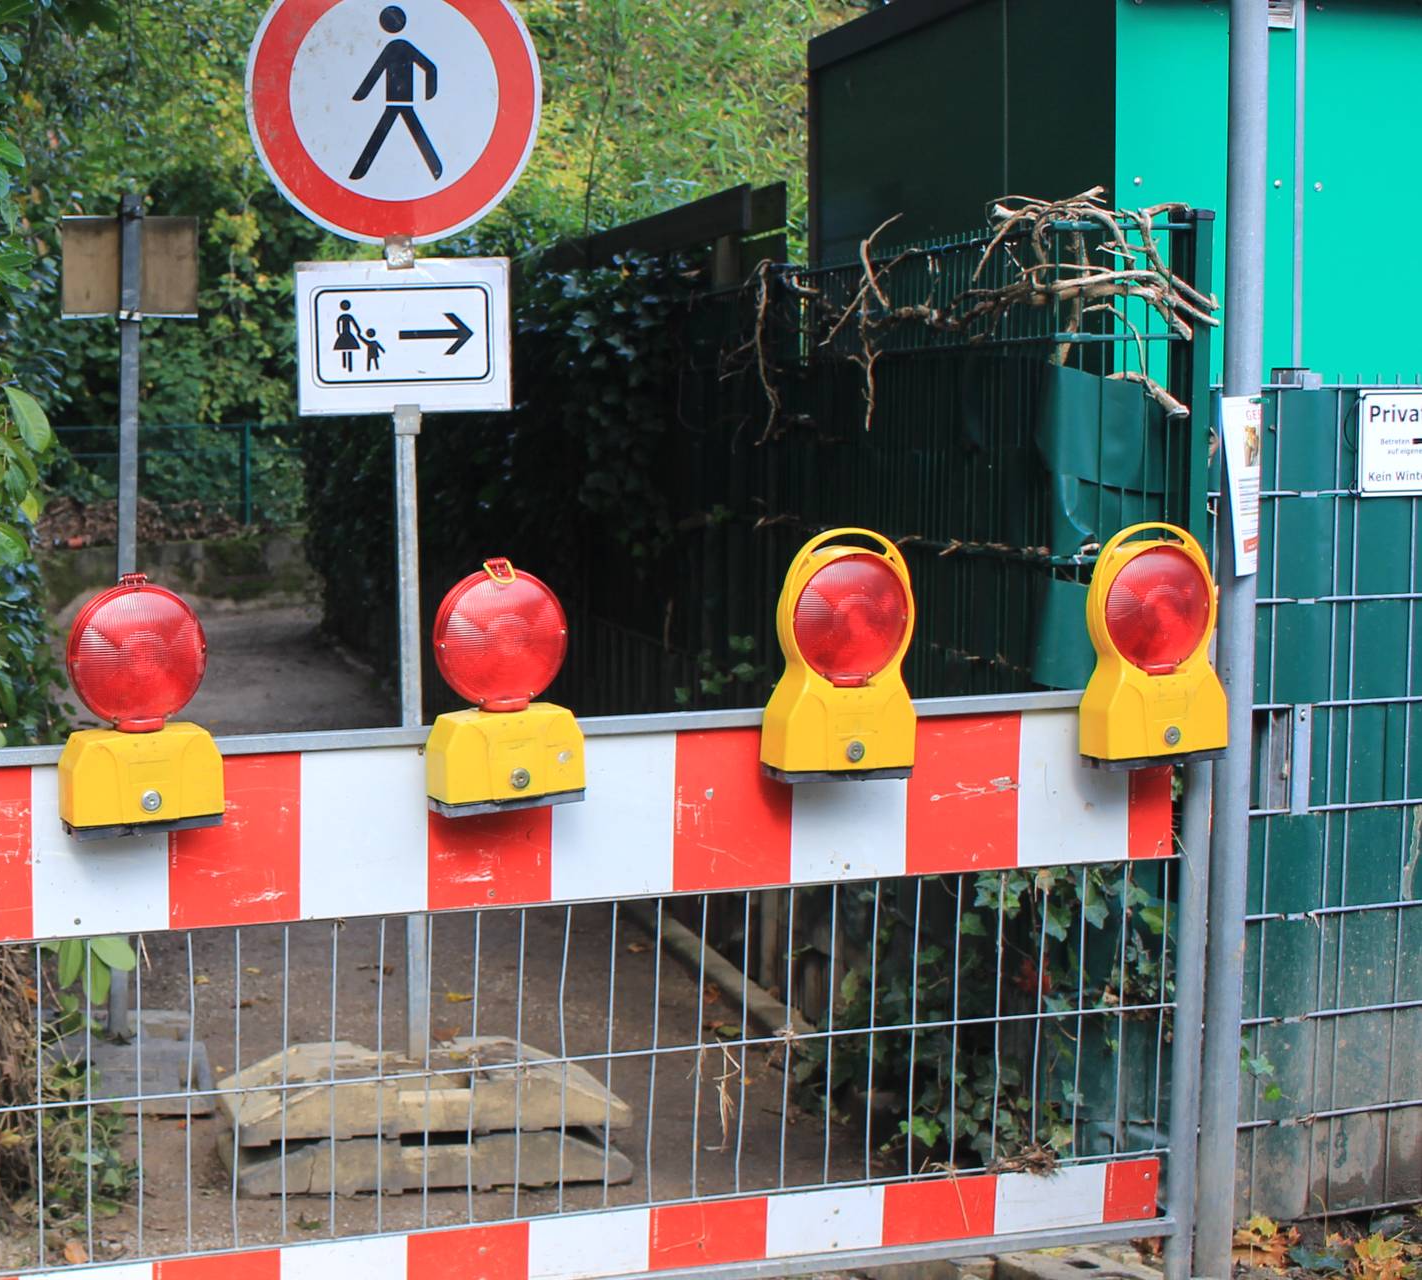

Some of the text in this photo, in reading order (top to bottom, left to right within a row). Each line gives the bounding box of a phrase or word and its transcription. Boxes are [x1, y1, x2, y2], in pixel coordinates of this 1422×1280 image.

[1369, 404, 1422, 423] Priva
[1380, 438, 1410, 446] Betreten
[1368, 471, 1392, 481] Kein
